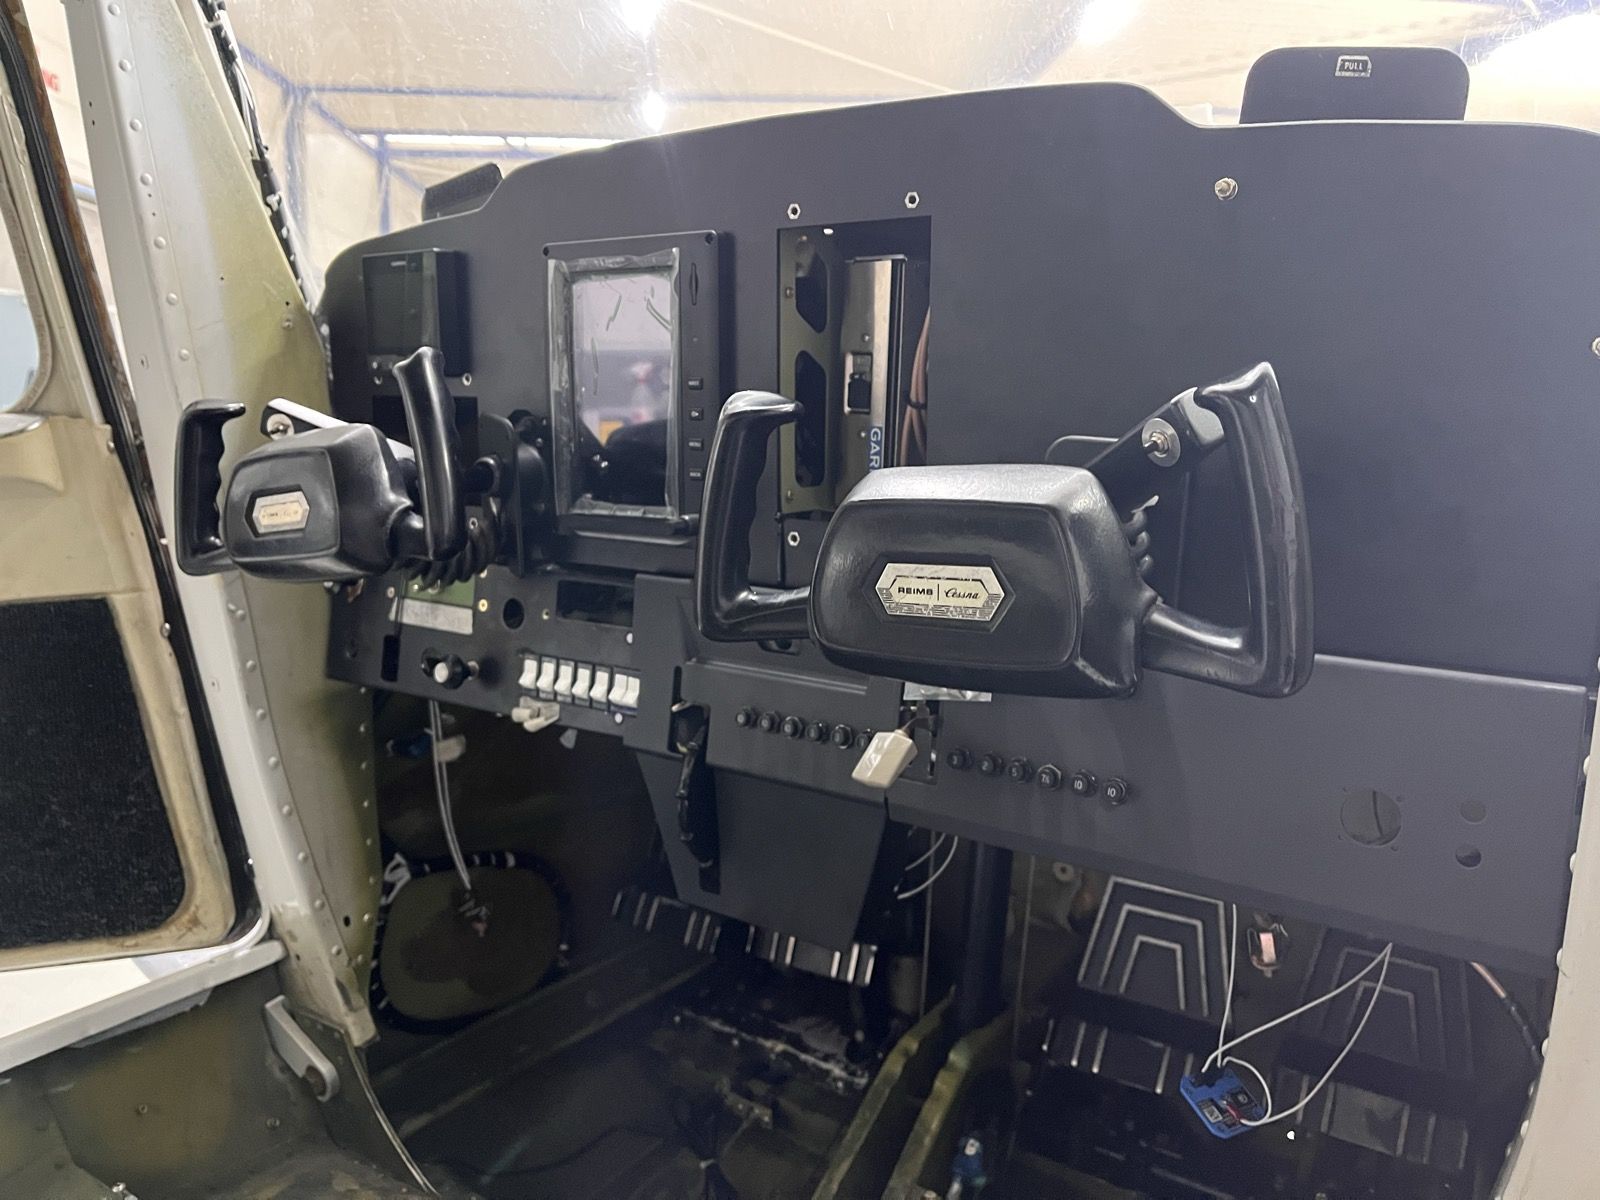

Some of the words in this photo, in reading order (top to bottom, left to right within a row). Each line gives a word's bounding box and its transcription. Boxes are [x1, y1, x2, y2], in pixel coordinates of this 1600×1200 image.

[1344, 61, 1363, 70] PULL
[870, 427, 881, 468] GAR
[944, 587, 980, 600] Cessna
[1011, 767, 1018, 777] 5
[1074, 780, 1083, 790] 10
[1107, 787, 1116, 798] 10
